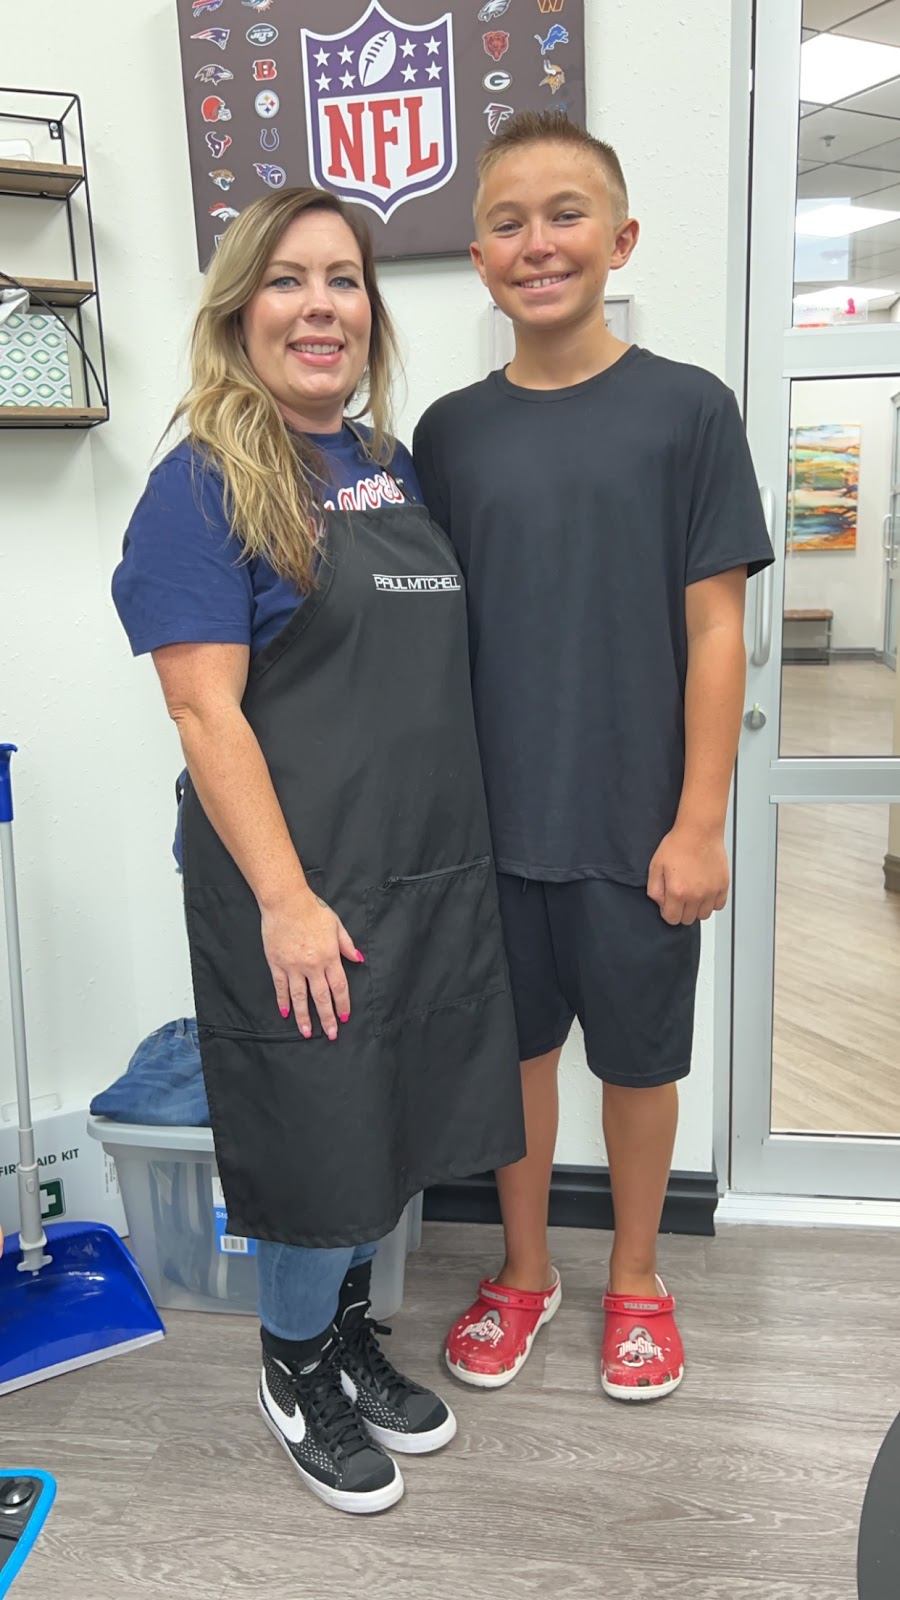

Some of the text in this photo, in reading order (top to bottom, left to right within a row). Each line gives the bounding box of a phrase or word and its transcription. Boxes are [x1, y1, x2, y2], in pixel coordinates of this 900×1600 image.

[484, 71, 511, 91] G
[324, 96, 439, 189] NFL
[374, 576, 461, 590] PAUL MITCHELL
[0, 1148, 79, 1177] FIR AID KIT
